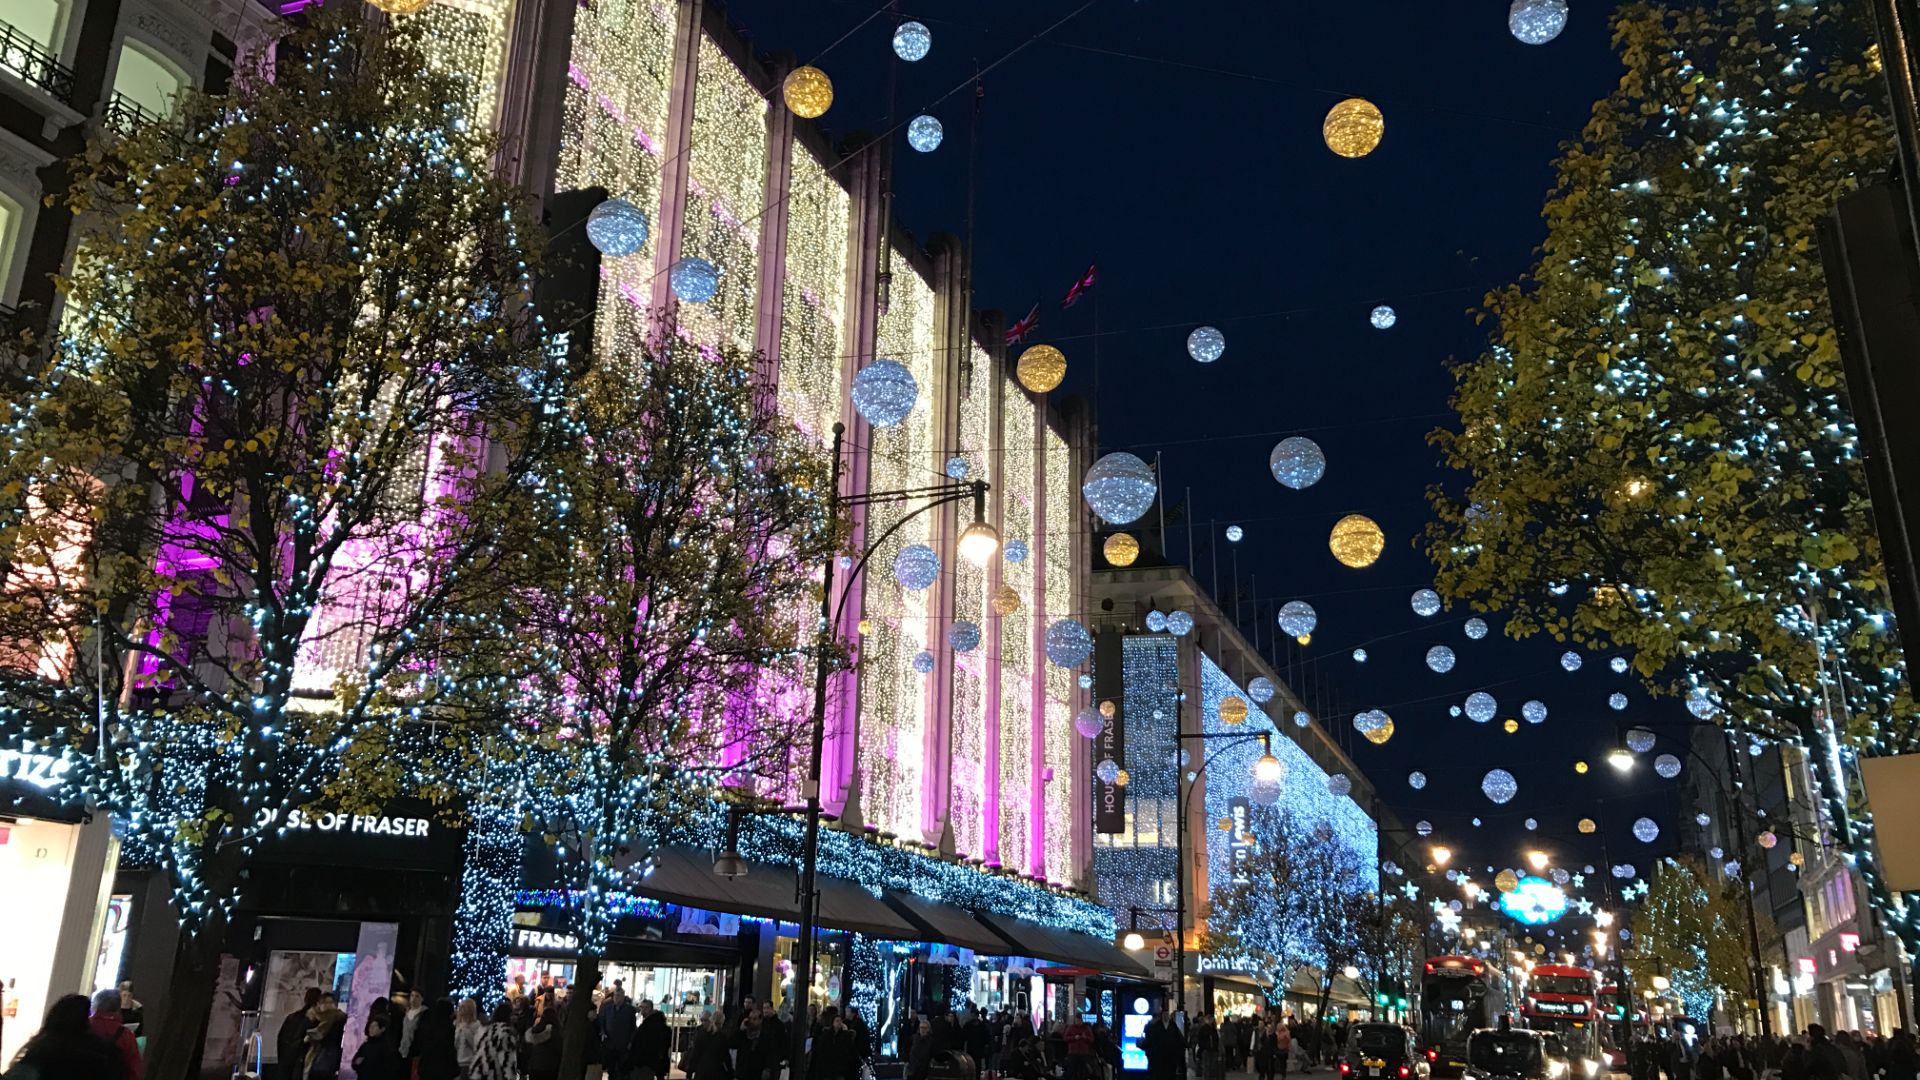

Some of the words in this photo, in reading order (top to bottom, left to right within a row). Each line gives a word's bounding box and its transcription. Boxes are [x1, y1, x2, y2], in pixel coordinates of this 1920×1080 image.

[317, 812, 349, 831] OF
[352, 815, 430, 837] FRASER
[518, 929, 578, 949] FRASE
